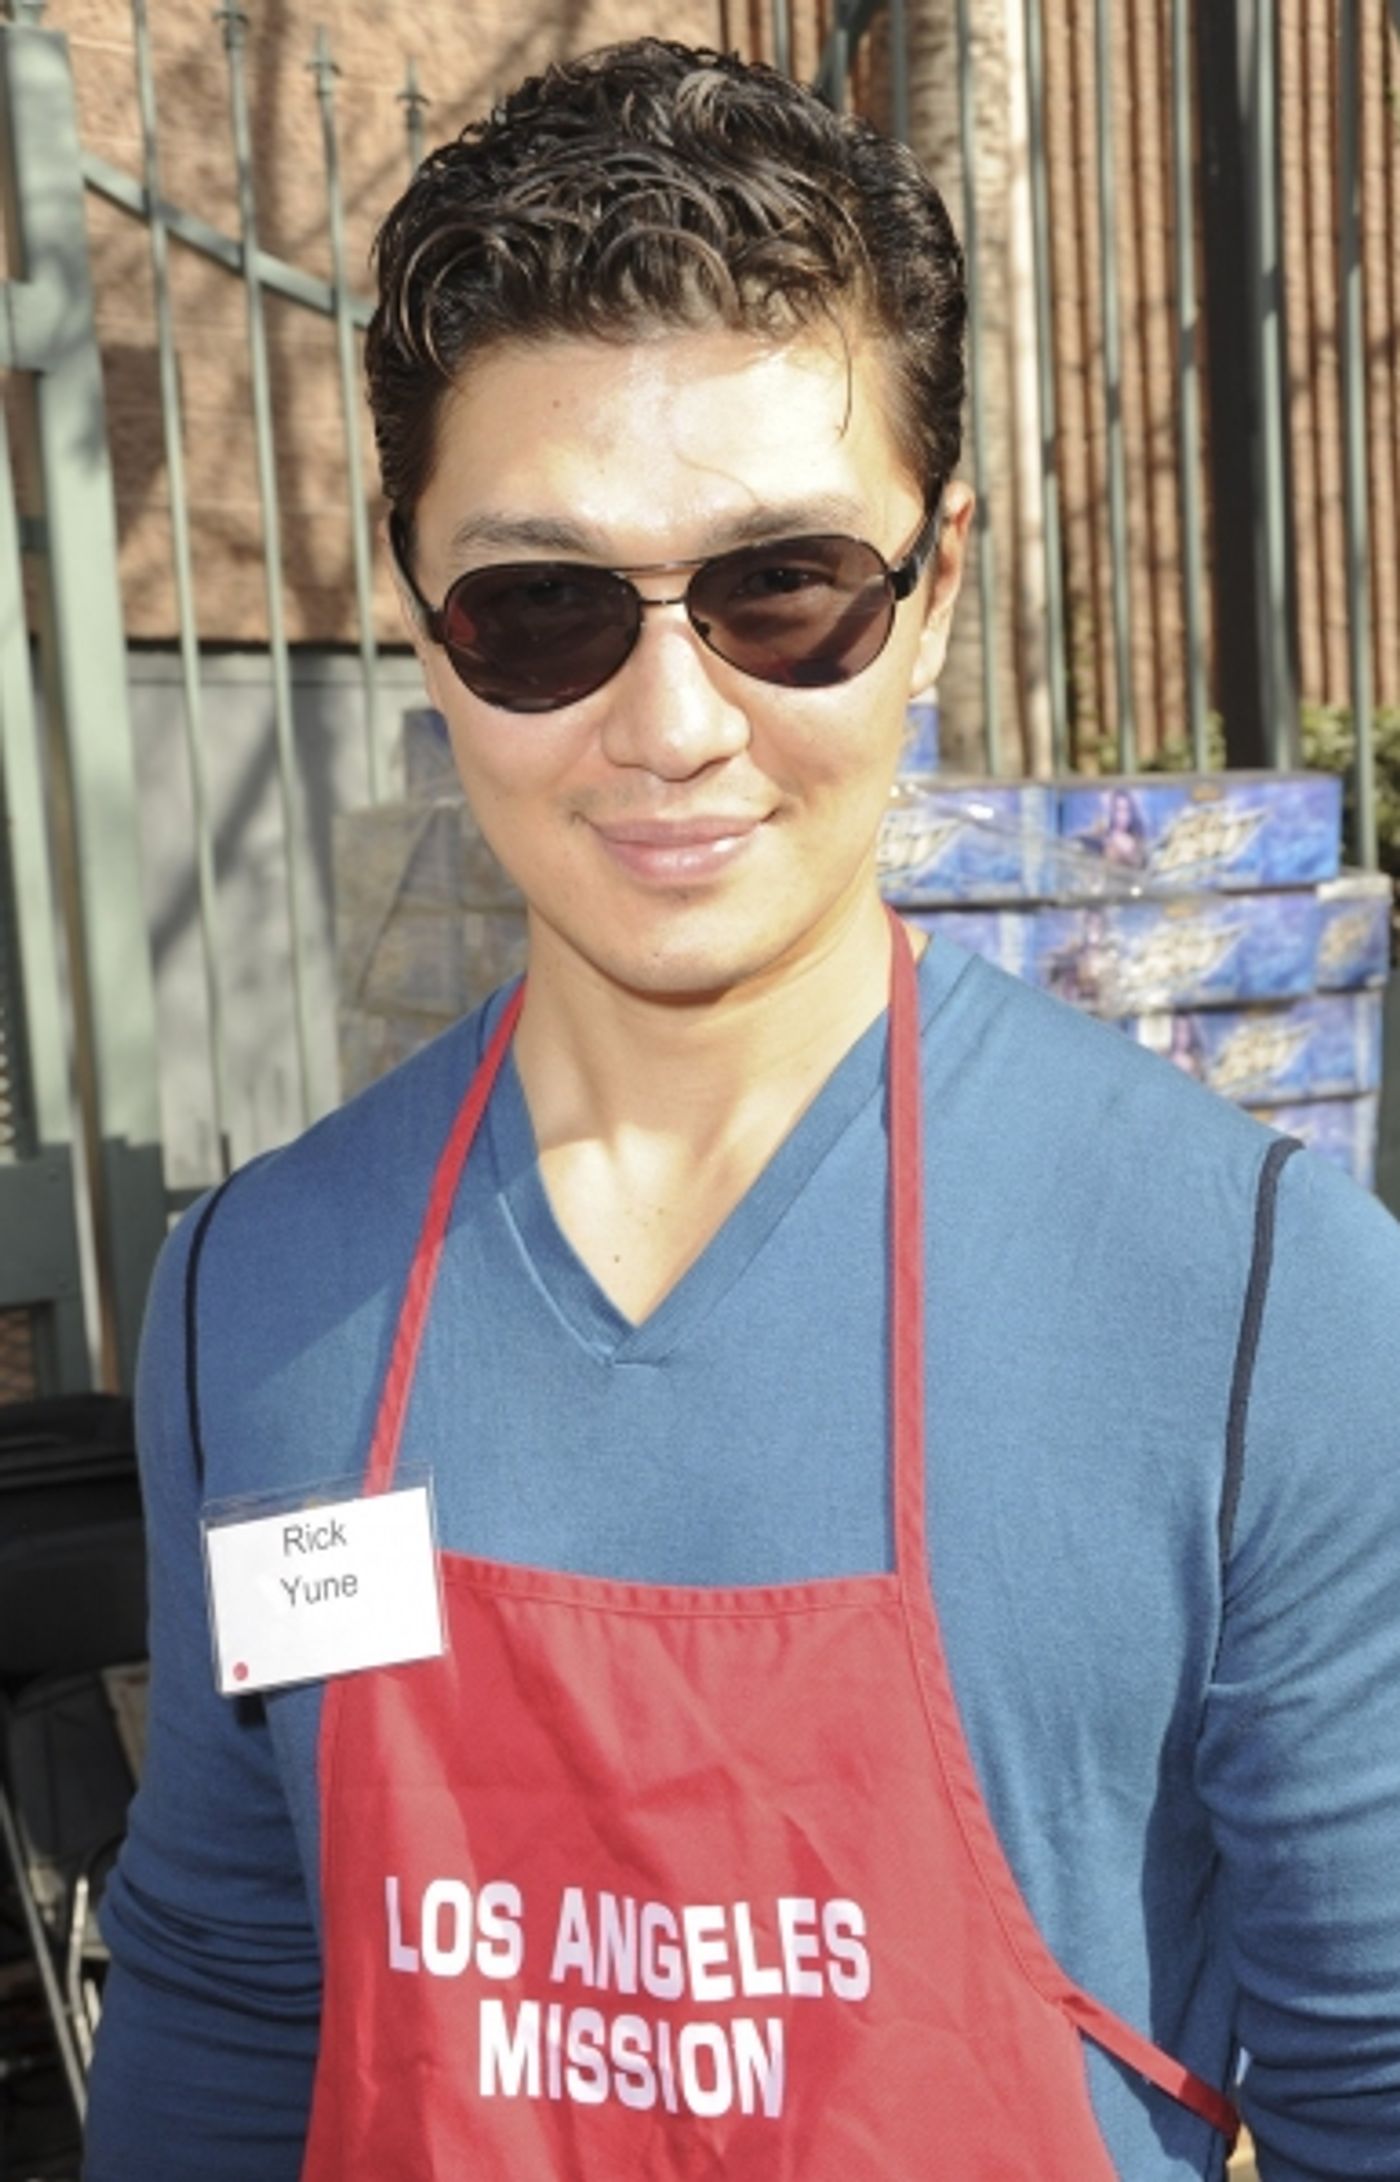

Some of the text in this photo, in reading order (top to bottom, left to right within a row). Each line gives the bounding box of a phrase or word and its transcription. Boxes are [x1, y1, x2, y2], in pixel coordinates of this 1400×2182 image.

[282, 1517, 347, 1557] Rick
[279, 1572, 358, 1607] Yune
[385, 1875, 871, 2003] LOS ANGELES
[479, 1998, 785, 2118] MISSION
